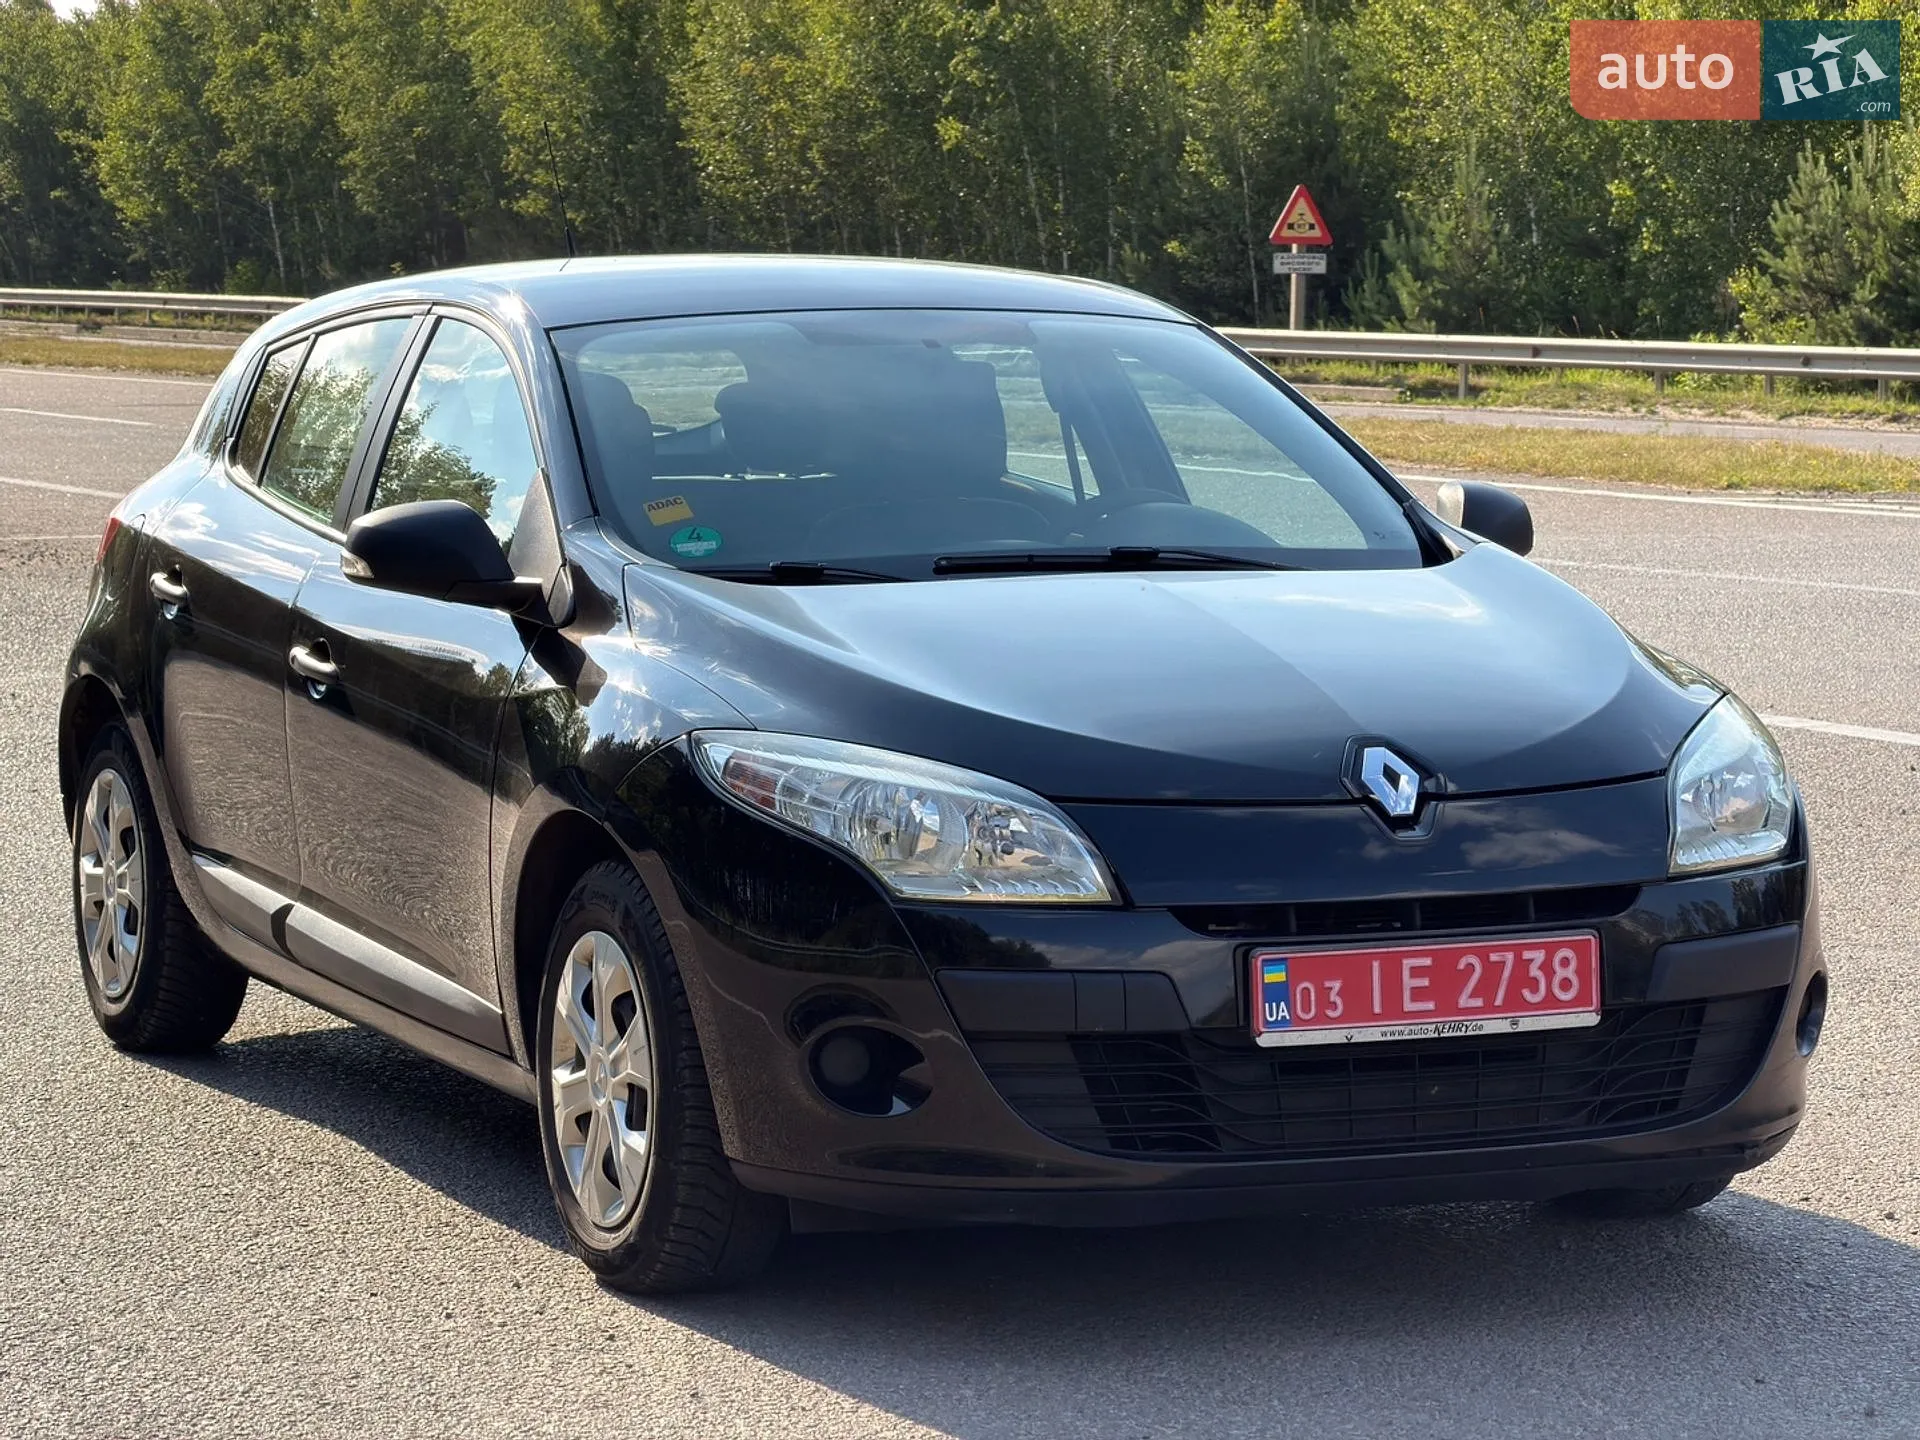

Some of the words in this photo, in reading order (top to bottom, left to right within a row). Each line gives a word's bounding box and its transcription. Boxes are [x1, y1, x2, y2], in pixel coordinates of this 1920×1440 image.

[647, 497, 684, 512] ADAC
[687, 527, 703, 541] 4
[1295, 980, 1344, 1021] 03
[1371, 957, 1436, 1015] IE
[1456, 948, 1580, 1010] 2738
[1264, 1001, 1290, 1022] UA
